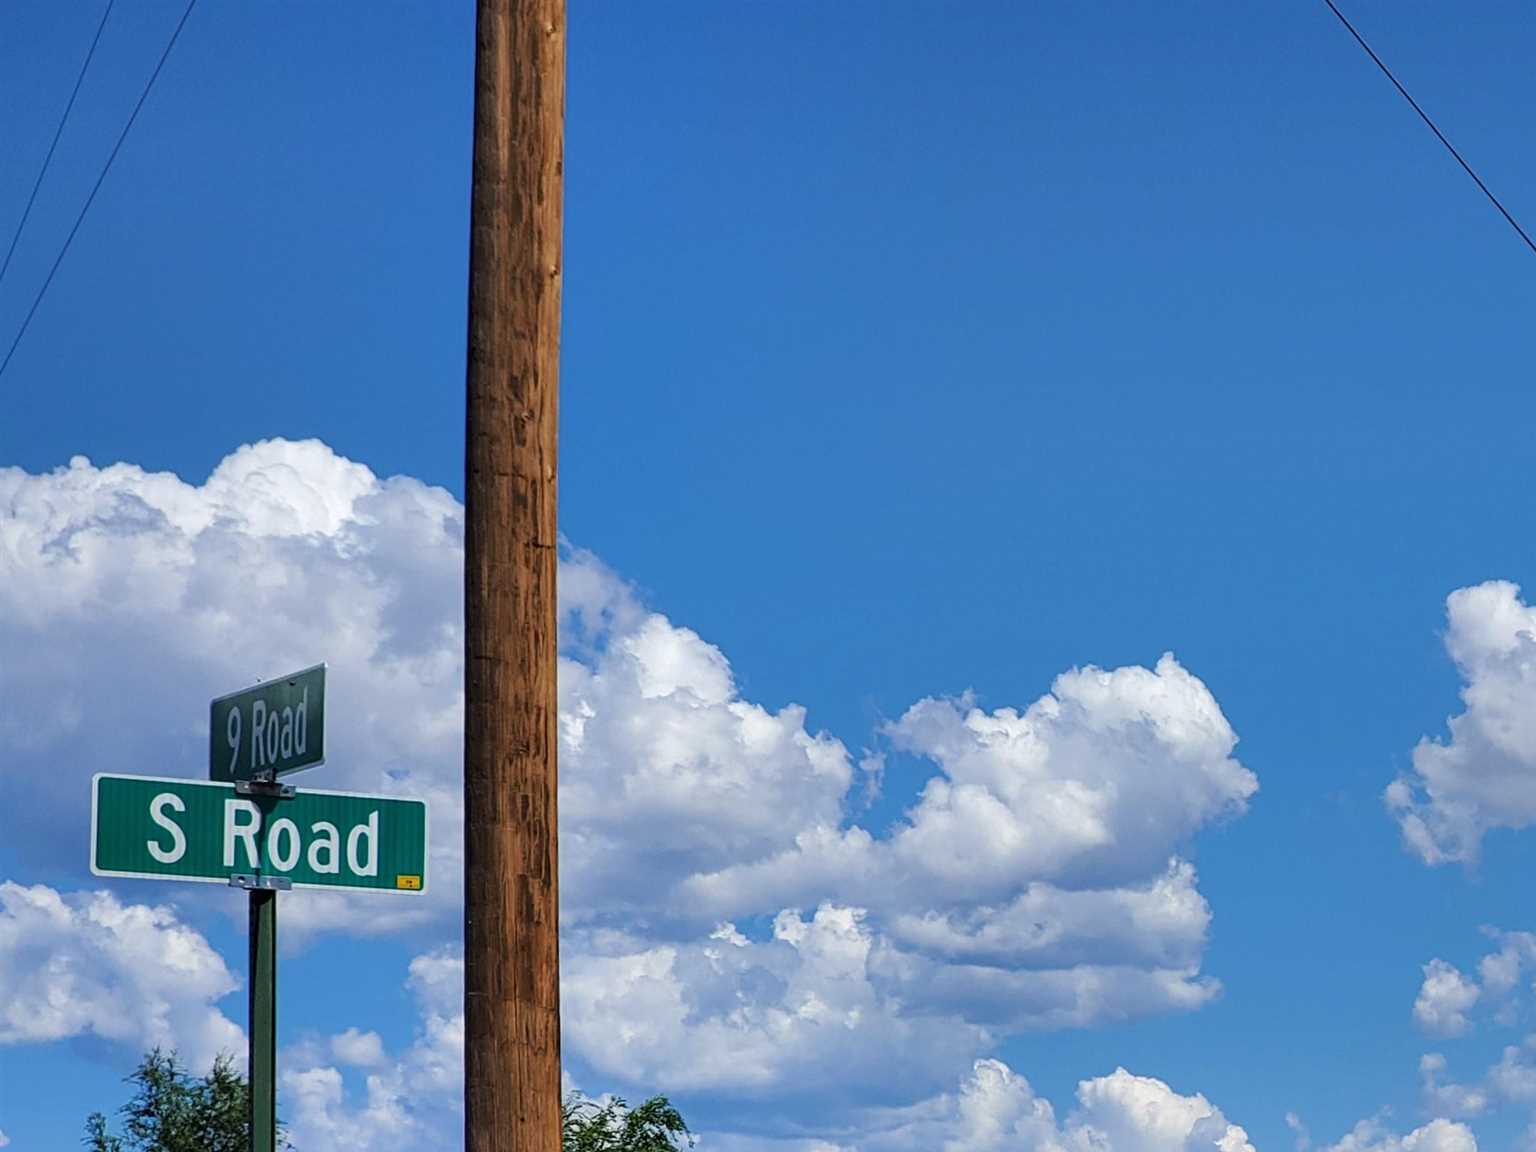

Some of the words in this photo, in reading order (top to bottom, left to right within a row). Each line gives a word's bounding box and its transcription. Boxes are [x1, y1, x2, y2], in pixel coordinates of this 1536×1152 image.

[227, 706, 241, 774] 9
[251, 686, 308, 768] Road
[147, 792, 187, 864] S
[223, 799, 379, 876] Road
